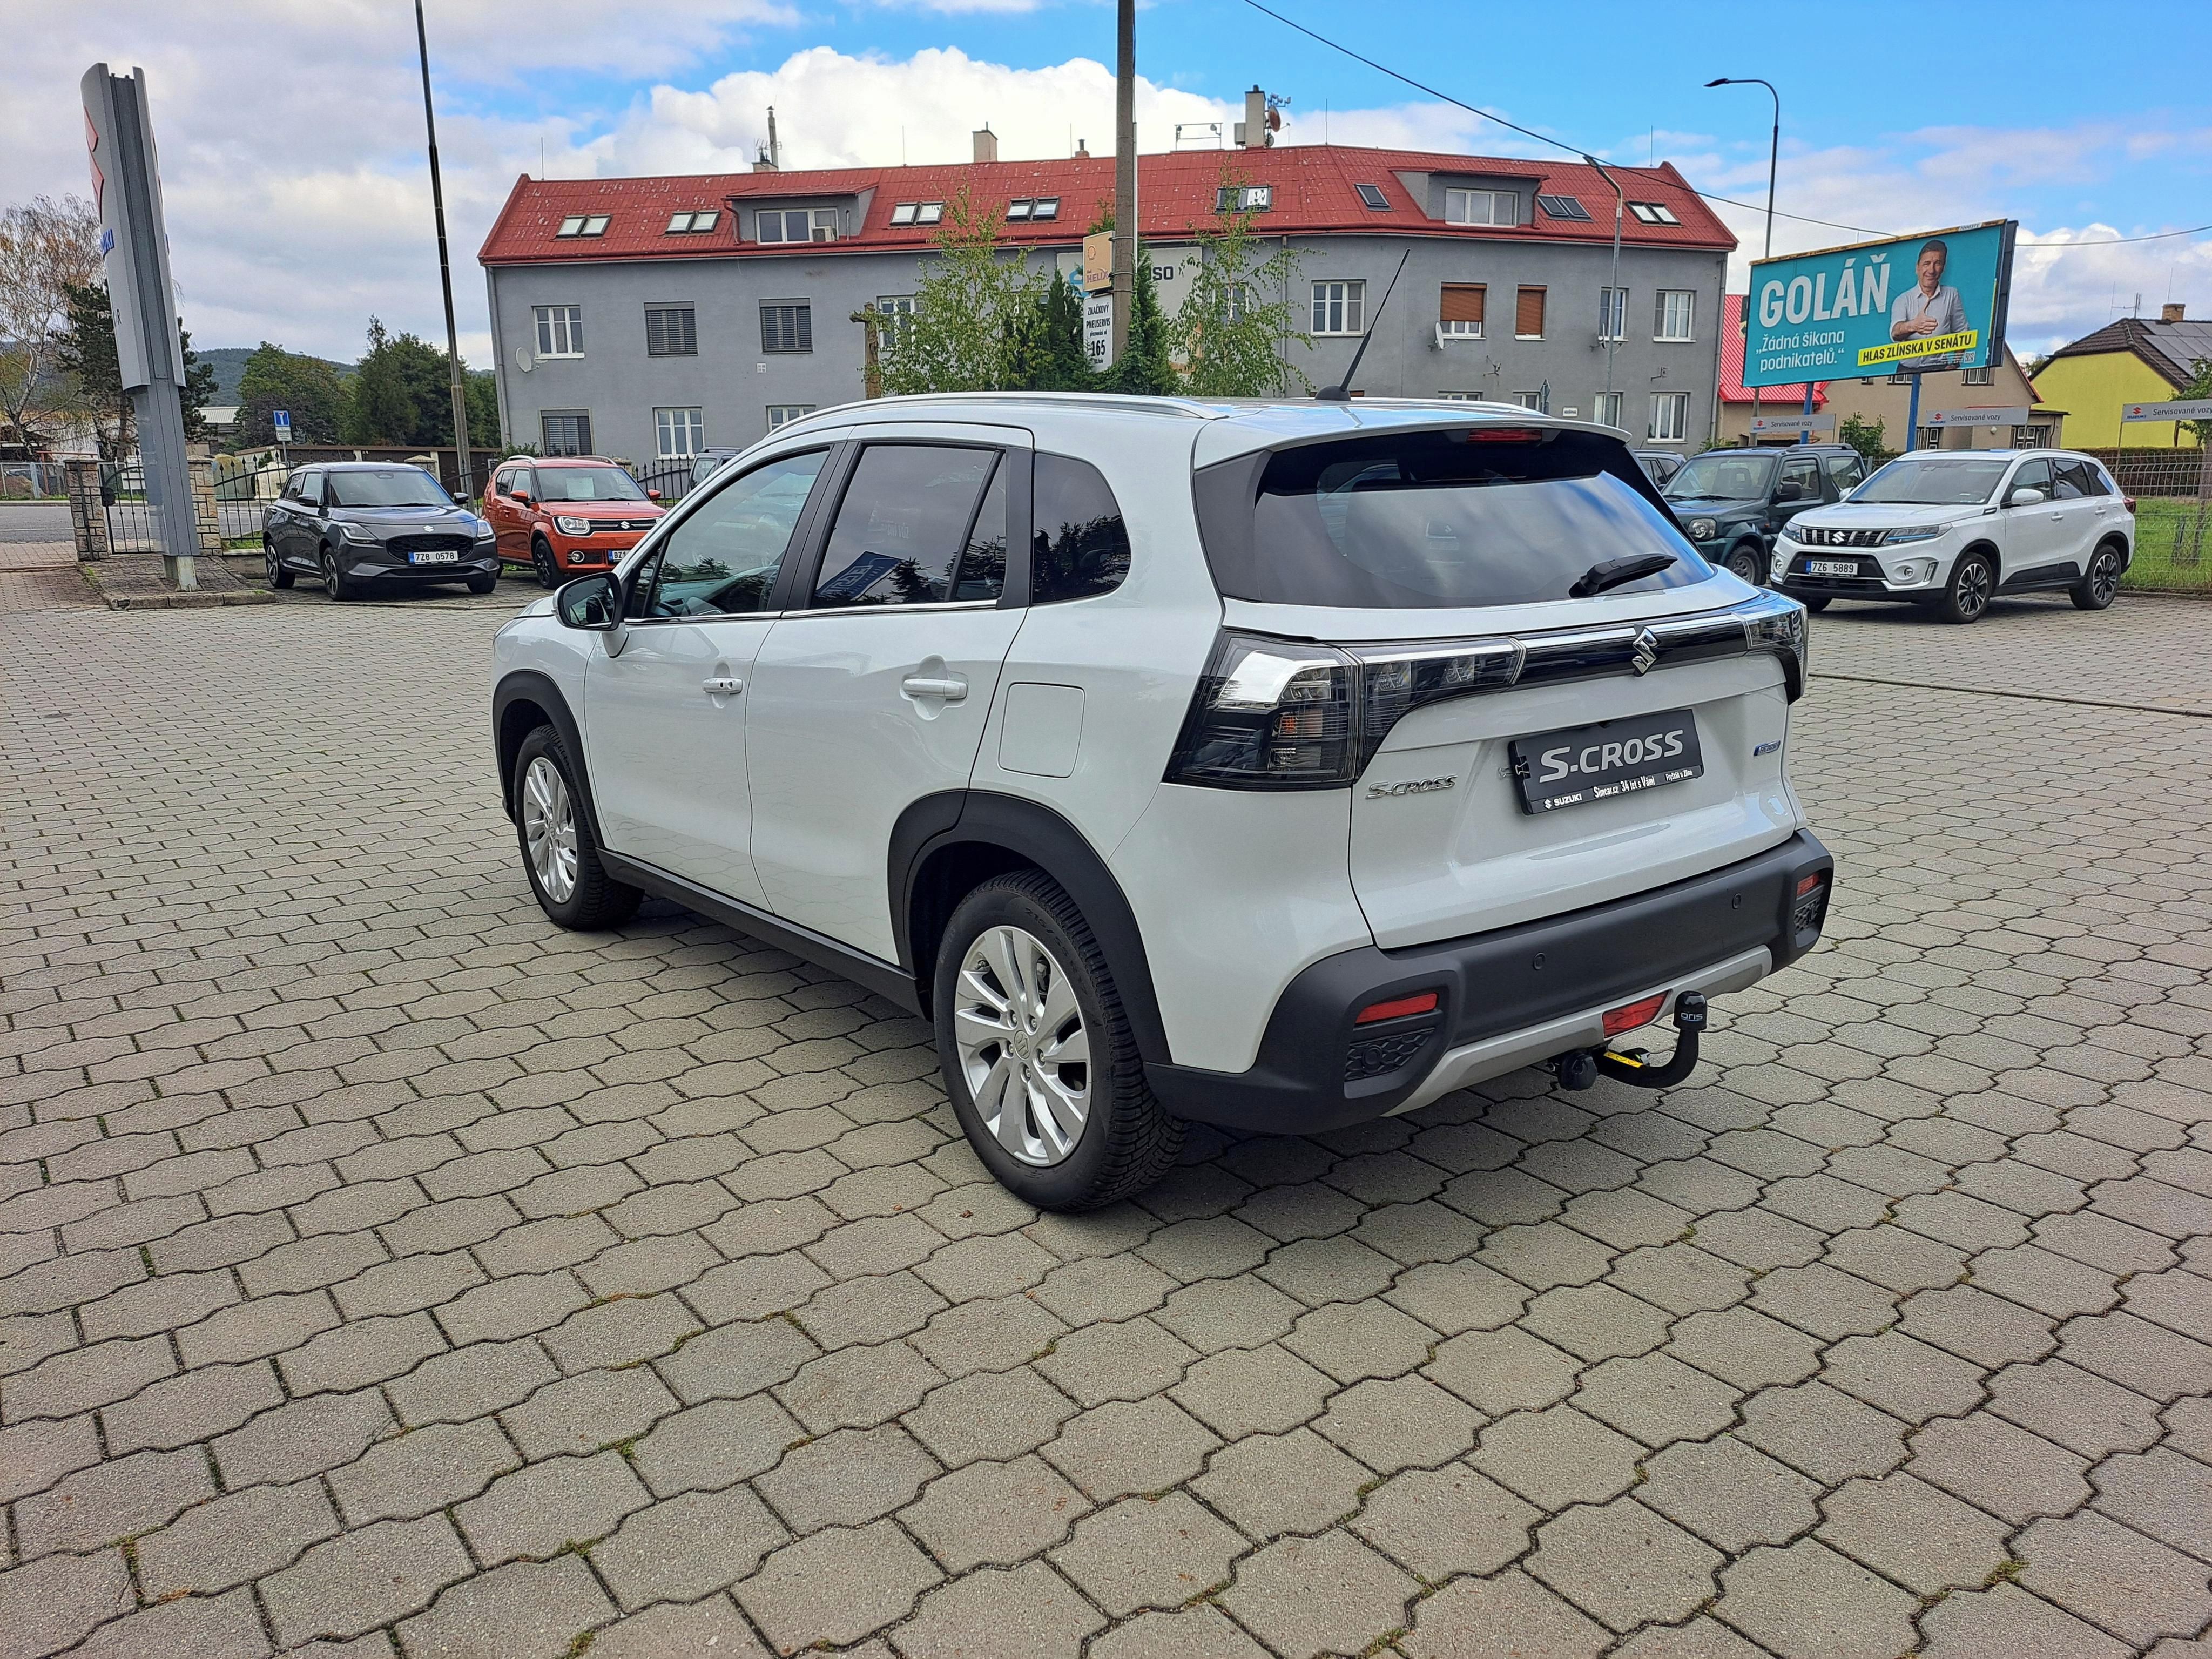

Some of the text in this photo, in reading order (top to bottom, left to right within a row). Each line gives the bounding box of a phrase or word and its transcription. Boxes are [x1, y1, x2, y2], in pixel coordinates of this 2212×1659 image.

[1150, 266, 1174, 280] SO
[1759, 253, 1890, 328] GOLÁŇ
[1087, 302, 1109, 316] ZNAČKOVÝ
[1086, 317, 1110, 329] PNEUSERVIS
[1802, 330, 1845, 347] šikana
[1091, 339, 1105, 356] 165
[1863, 334, 1972, 362] HLAS ZLÍNSKA V SENÁTU
[2153, 407, 2195, 415] Servisované
[415, 553, 430, 561] 7Z8
[1812, 562, 1854, 573] 7Z6 5889
[1539, 730, 1683, 783] S-CROSS
[1365, 774, 1458, 800] S-CROSS
[1554, 793, 1582, 806] SUZUKI
[1593, 785, 1619, 798] Simcar.cz
[1620, 780, 1629, 792] 34
[1630, 780, 1638, 790] let
